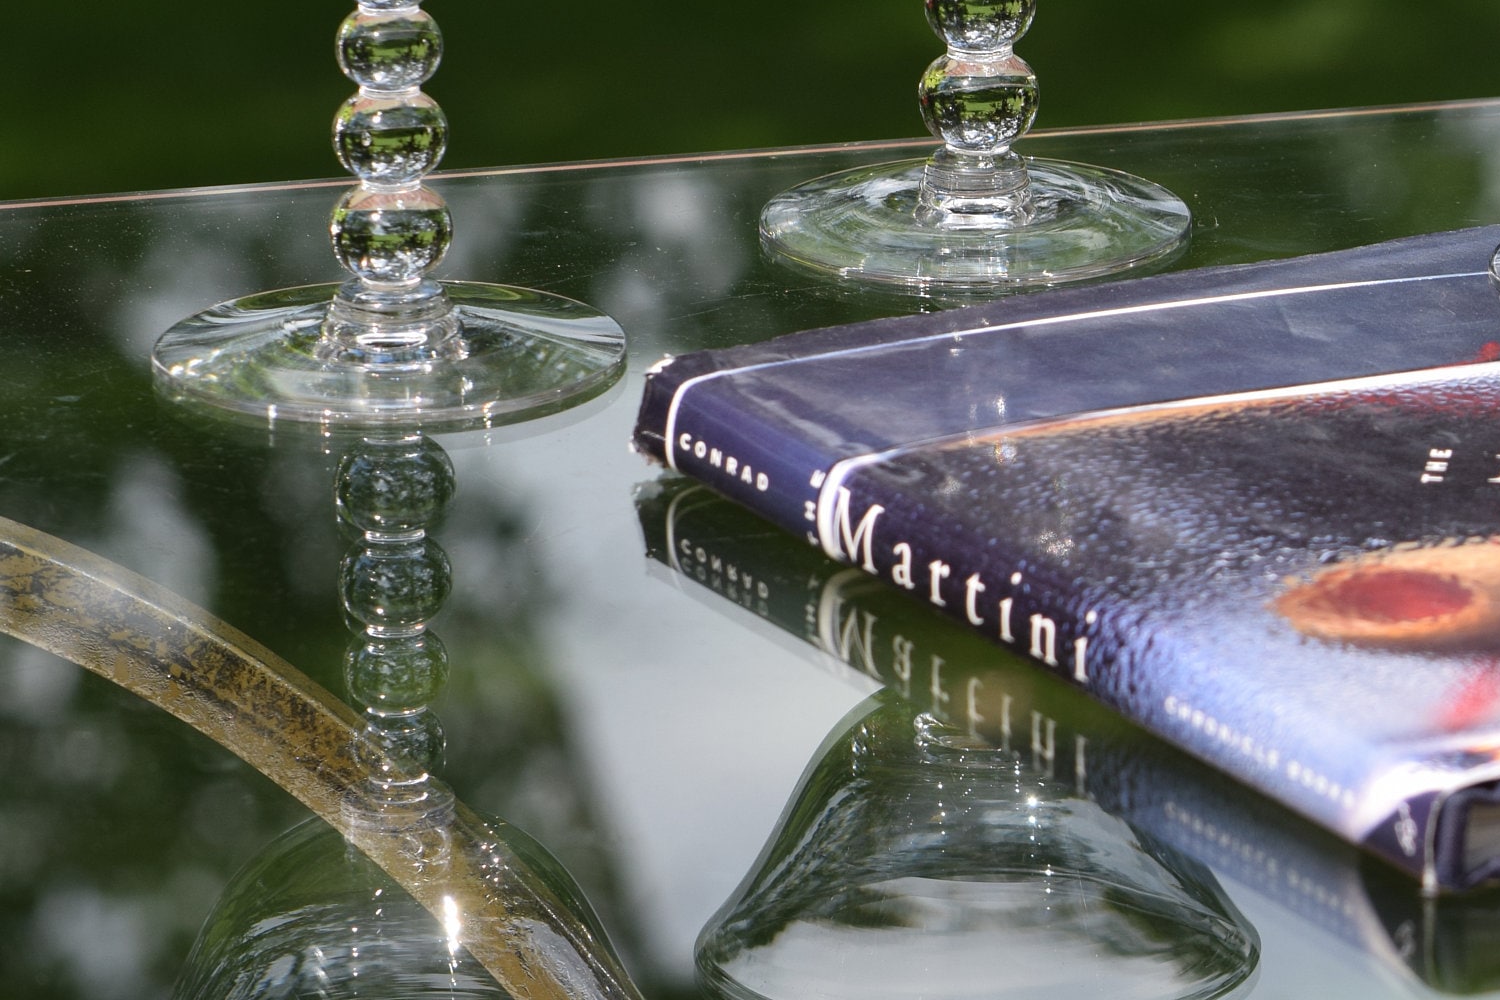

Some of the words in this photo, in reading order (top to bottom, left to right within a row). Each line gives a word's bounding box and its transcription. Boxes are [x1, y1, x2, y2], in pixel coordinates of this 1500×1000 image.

[679, 432, 769, 492] CONRAD
[1421, 447, 1452, 483] THE
[833, 485, 1098, 684] Martini
